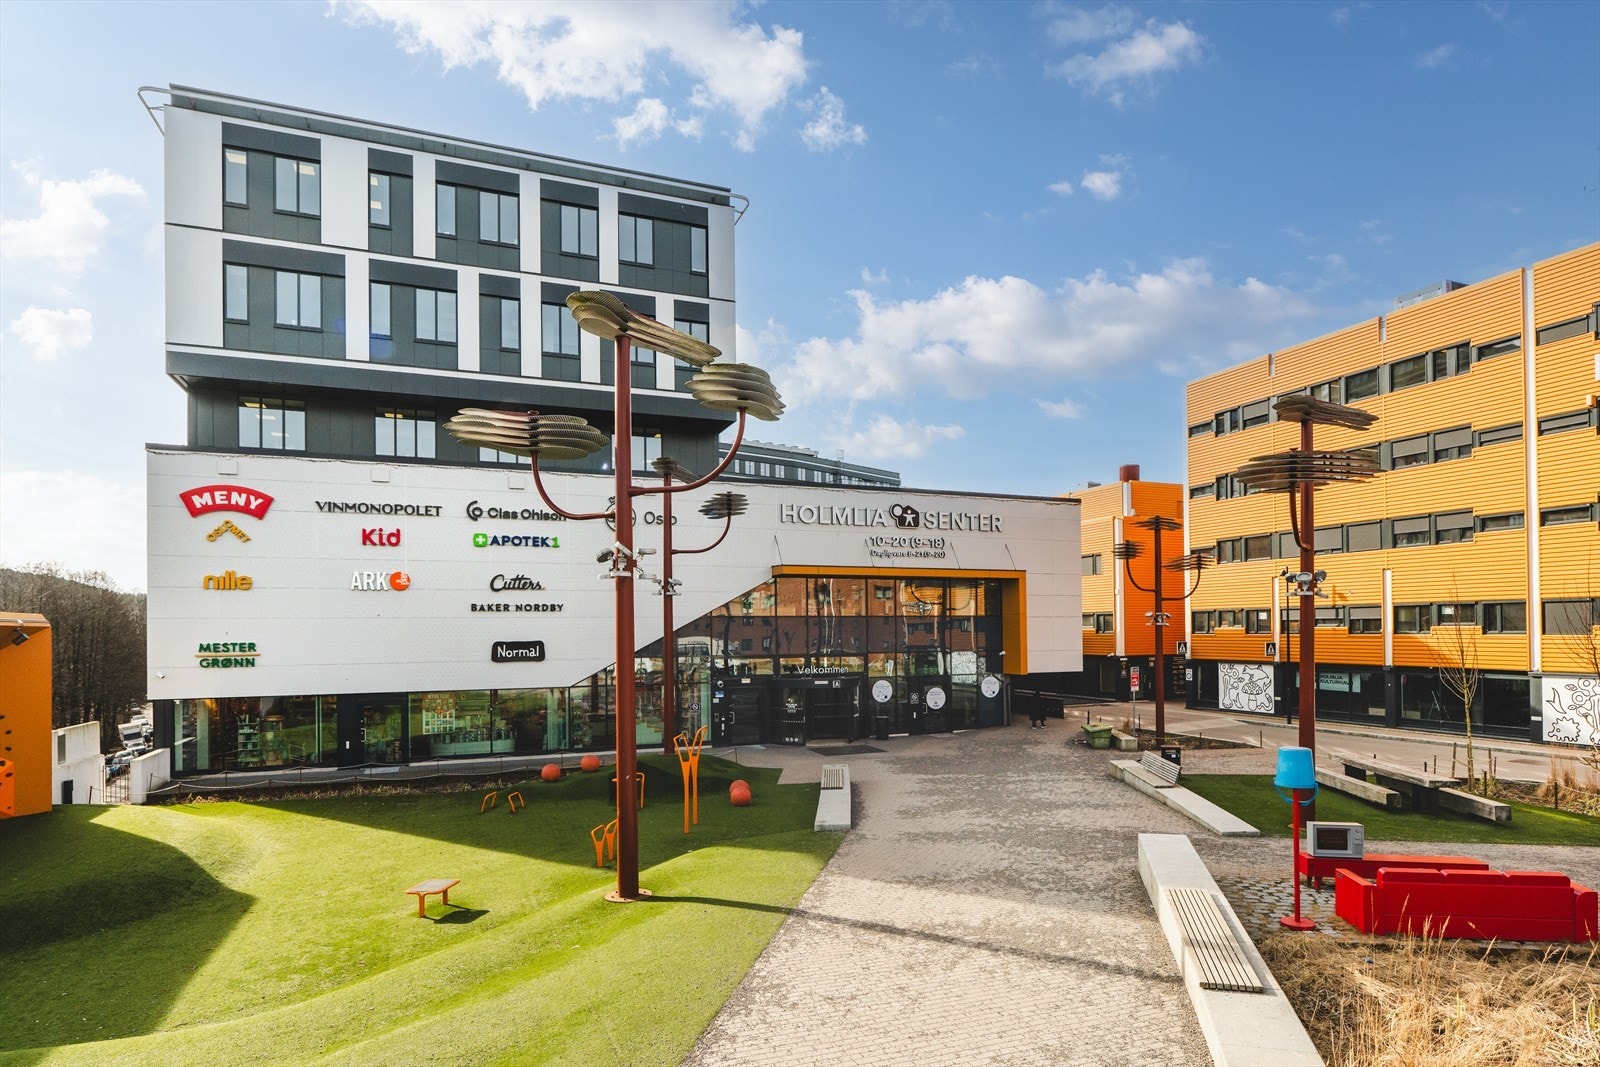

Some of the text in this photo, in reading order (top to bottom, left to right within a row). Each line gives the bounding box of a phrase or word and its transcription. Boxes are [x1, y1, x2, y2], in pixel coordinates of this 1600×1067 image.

[191, 491, 264, 510] MENY
[315, 501, 442, 517] VINMONOPOLET
[487, 507, 518, 519] Clas
[644, 511, 677, 525] Oso
[780, 503, 1002, 532] HOLMLIA SENTER
[361, 528, 401, 547] Kid
[489, 535, 550, 548] APOTEK
[203, 570, 253, 590] nille
[350, 571, 388, 591] ARK
[470, 603, 564, 612] BAKER NORDBY
[198, 642, 257, 653] MESTER
[497, 642, 540, 658] Normal
[199, 657, 256, 669] GRØNN
[797, 665, 849, 675] Velkommen
